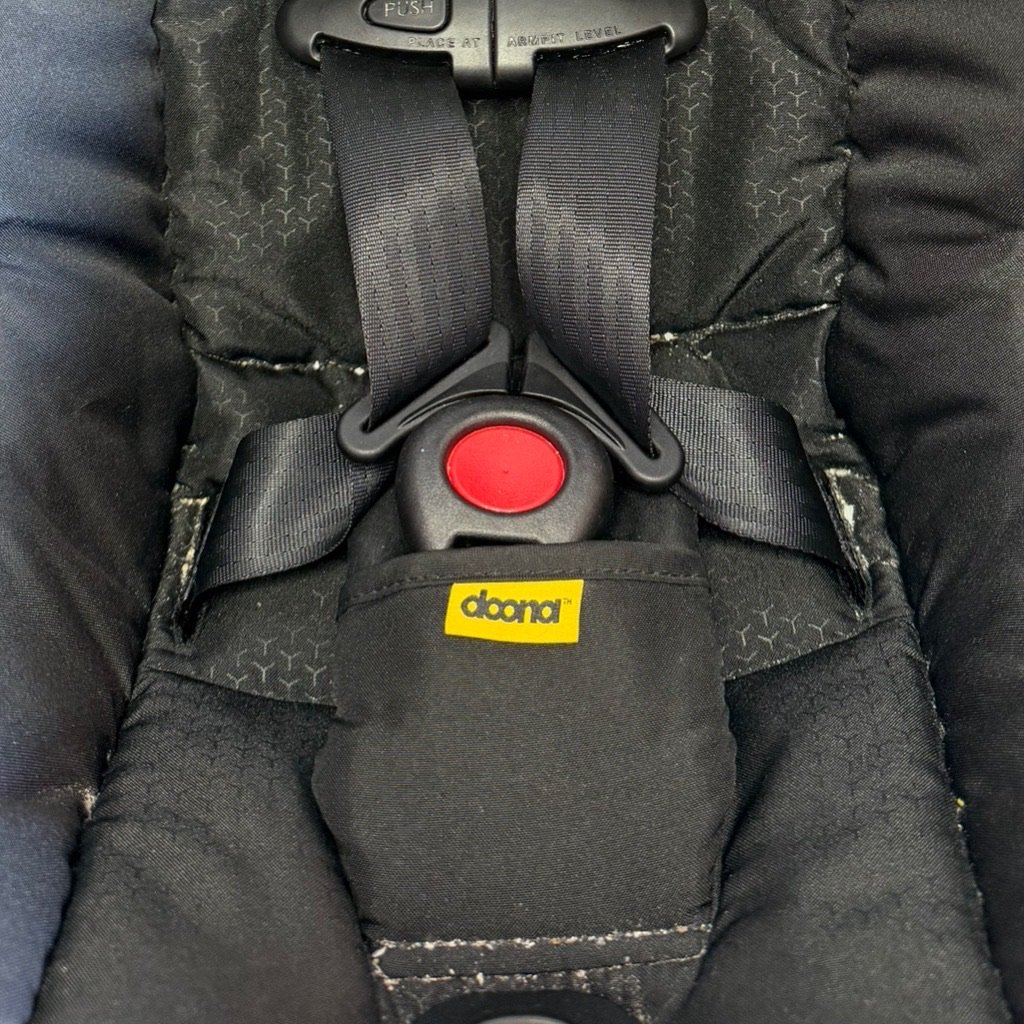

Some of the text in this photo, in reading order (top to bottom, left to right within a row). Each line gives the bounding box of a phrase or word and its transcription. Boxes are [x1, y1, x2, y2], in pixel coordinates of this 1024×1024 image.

[383, 0, 435, 17] PUSH
[407, 25, 622, 49] PLACE AT ARMPIT LEVEL
